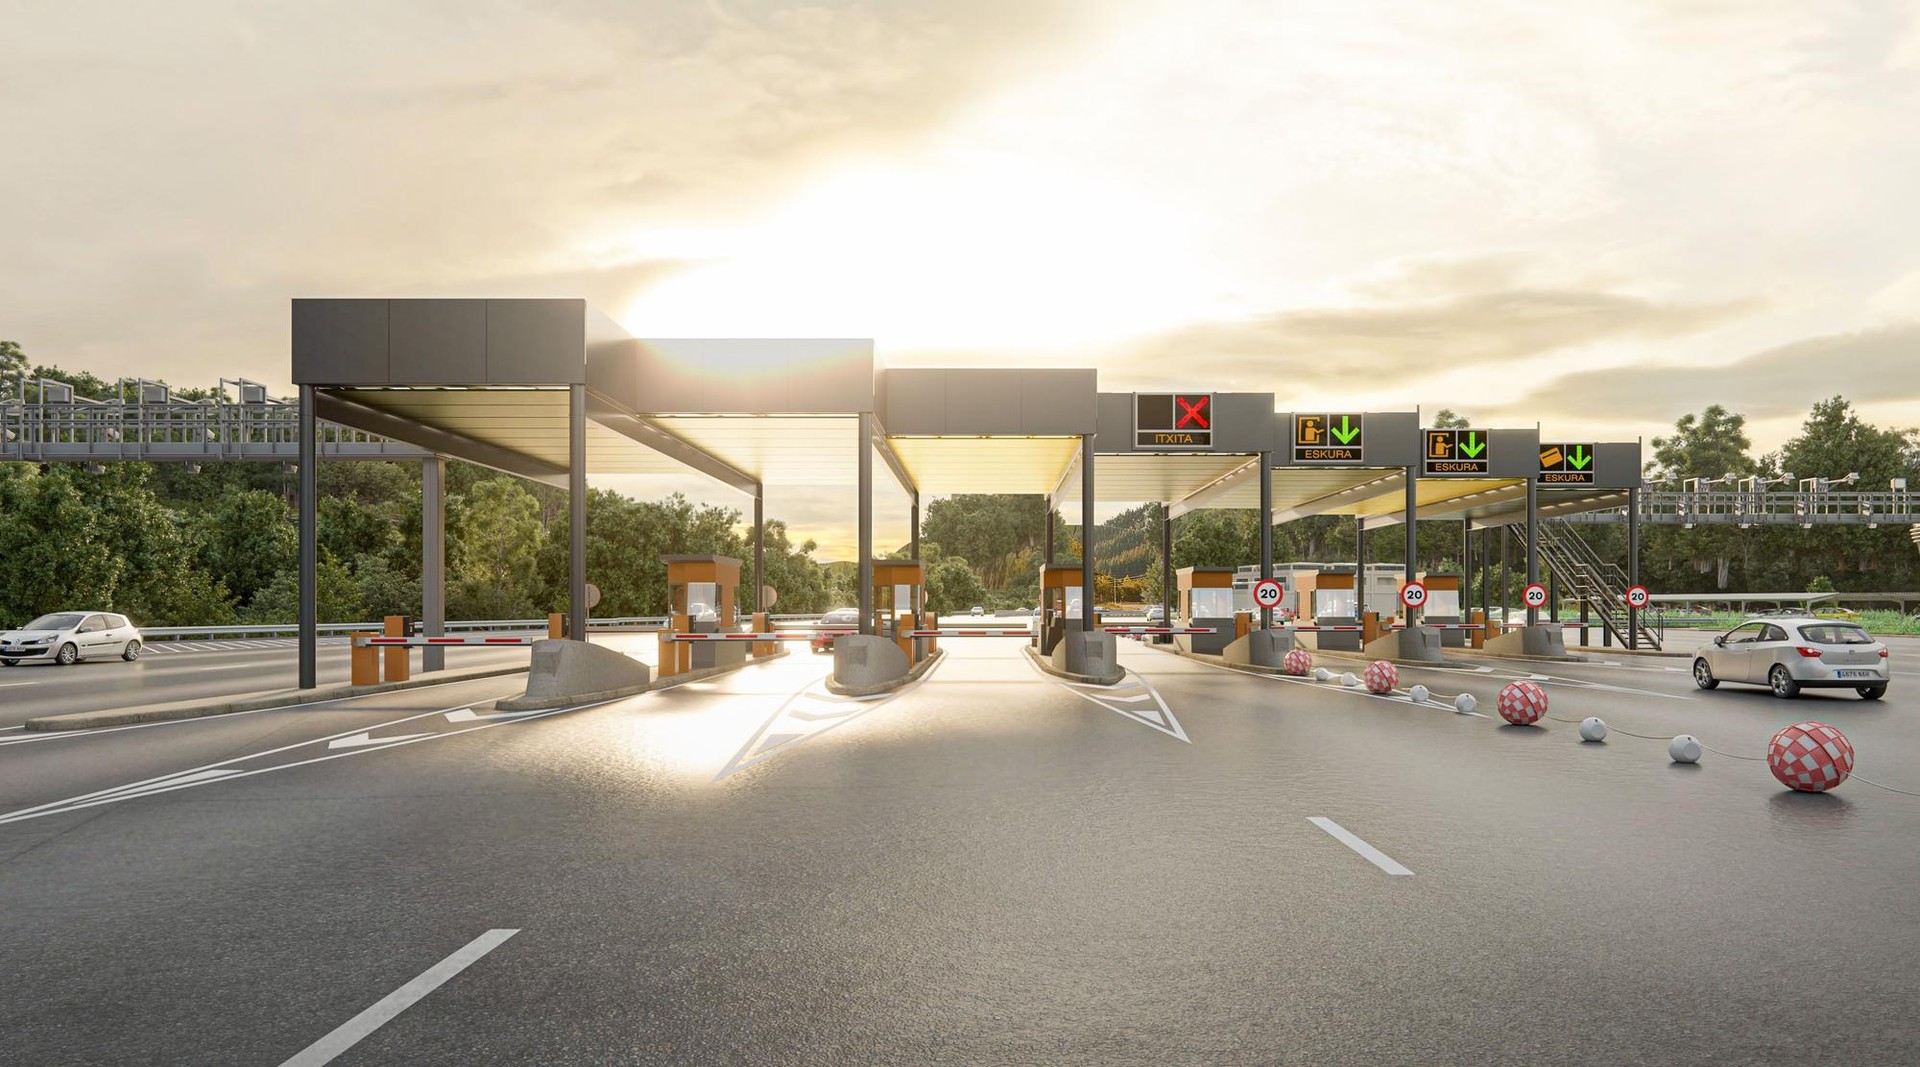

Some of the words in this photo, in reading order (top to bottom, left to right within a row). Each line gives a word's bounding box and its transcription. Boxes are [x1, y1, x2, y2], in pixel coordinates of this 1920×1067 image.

[1155, 434, 1193, 443] ITXITA
[1305, 450, 1353, 458] ESKURA
[1435, 463, 1478, 471] ESKURA
[1260, 588, 1278, 599] 20
[1407, 590, 1422, 600] 20
[1528, 591, 1543, 600] 20
[1631, 592, 1644, 600] 20
